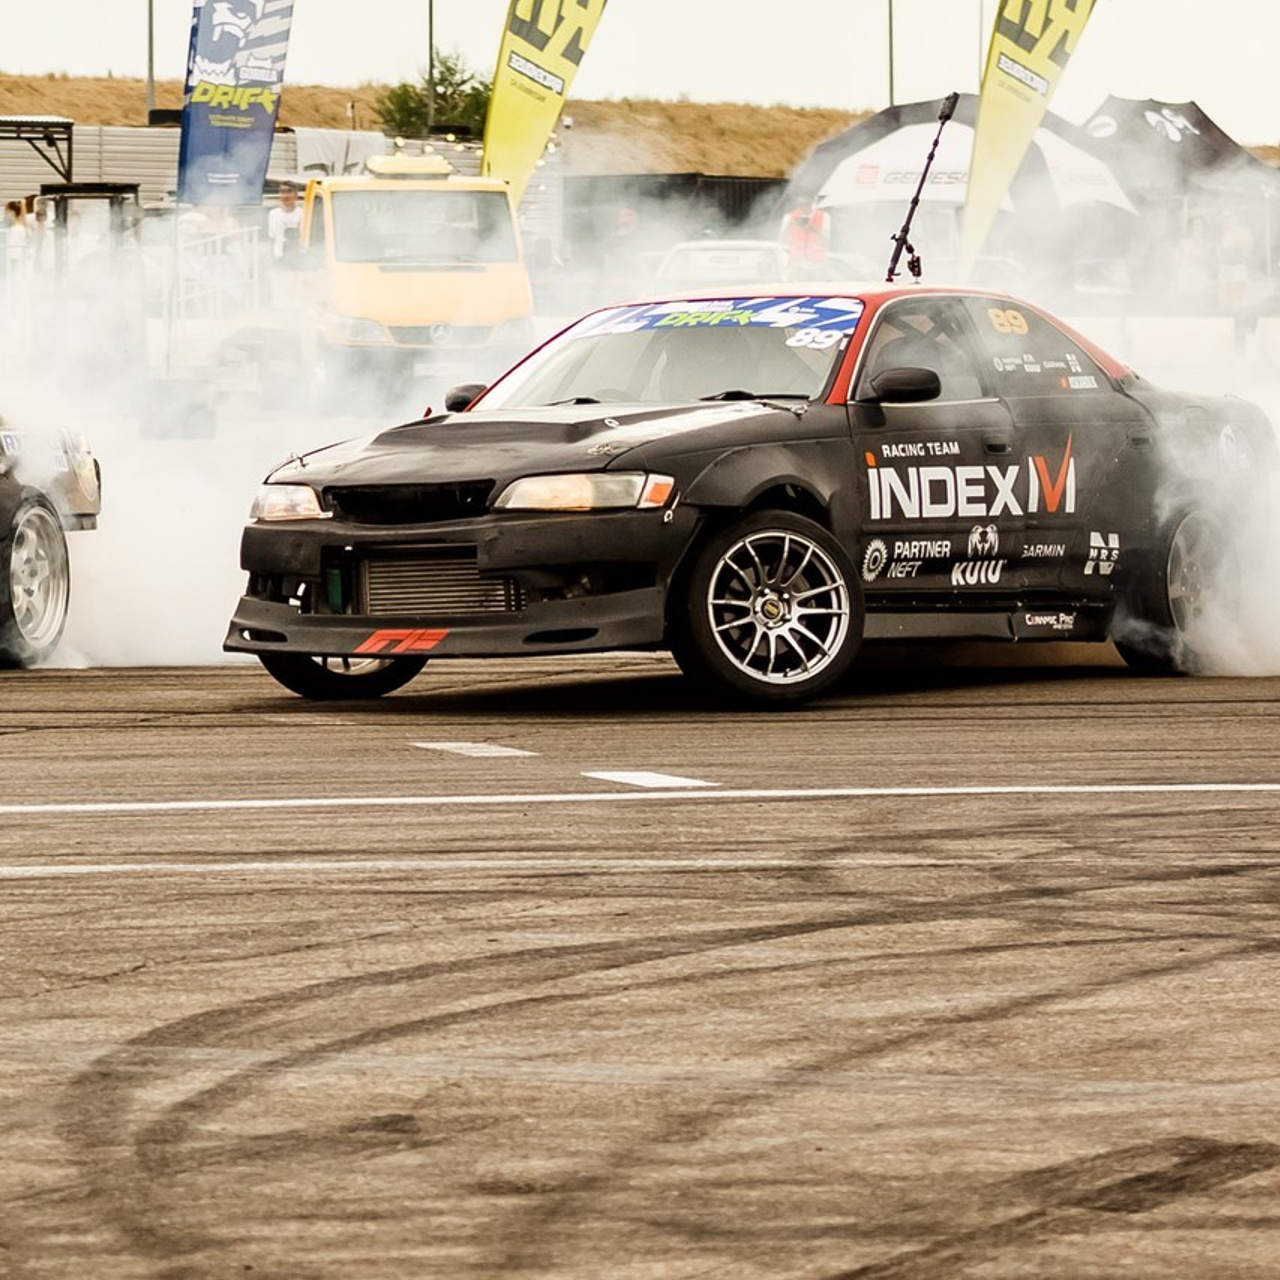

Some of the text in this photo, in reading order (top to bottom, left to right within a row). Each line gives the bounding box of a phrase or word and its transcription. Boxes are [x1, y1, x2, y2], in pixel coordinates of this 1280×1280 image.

[987, 308, 1029, 336] 89
[785, 328, 844, 350] 89
[882, 442, 960, 458] RACING TEAM
[893, 541, 951, 559] PARTNER
[887, 561, 923, 578] NEFT
[951, 560, 1003, 586] KUIU
